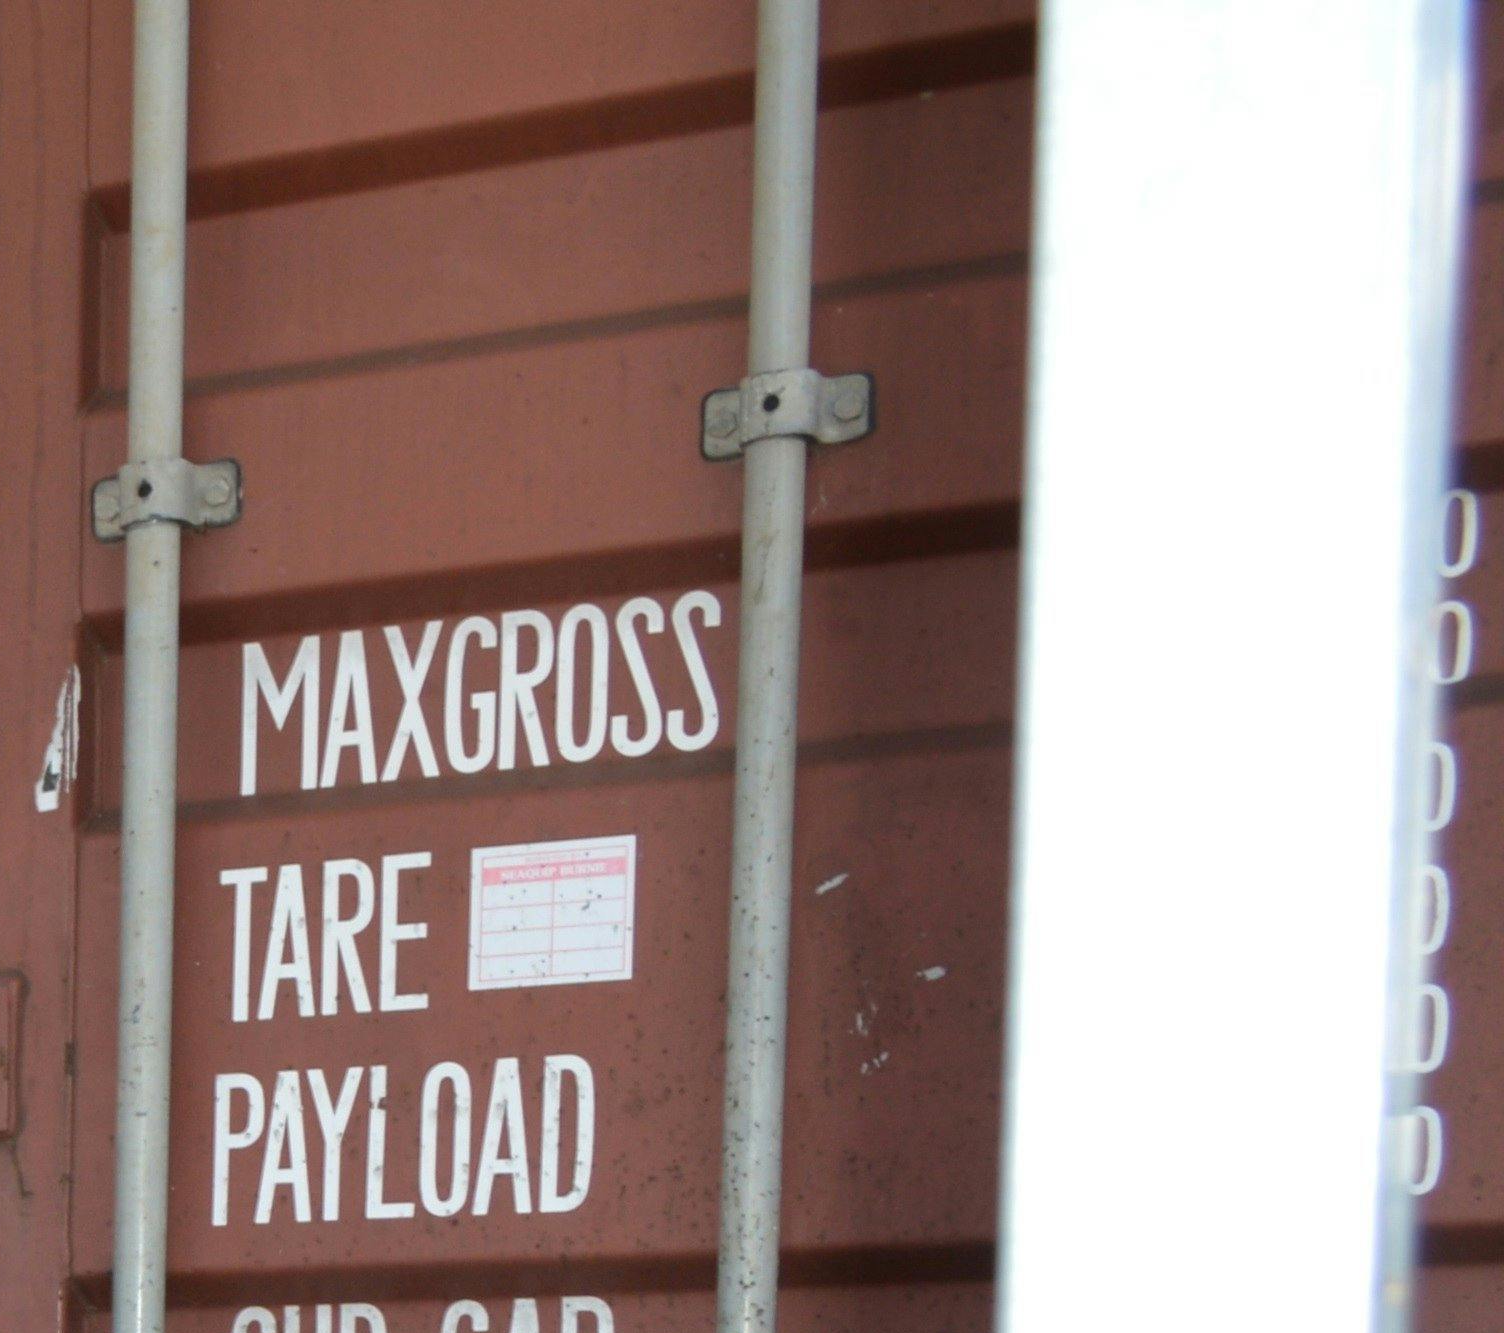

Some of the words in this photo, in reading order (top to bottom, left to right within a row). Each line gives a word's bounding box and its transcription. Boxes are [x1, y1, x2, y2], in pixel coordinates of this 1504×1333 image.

[240, 590, 721, 797] MAXGROSS
[219, 851, 433, 1022] TARE
[211, 1053, 596, 1227] PAYLOAD
